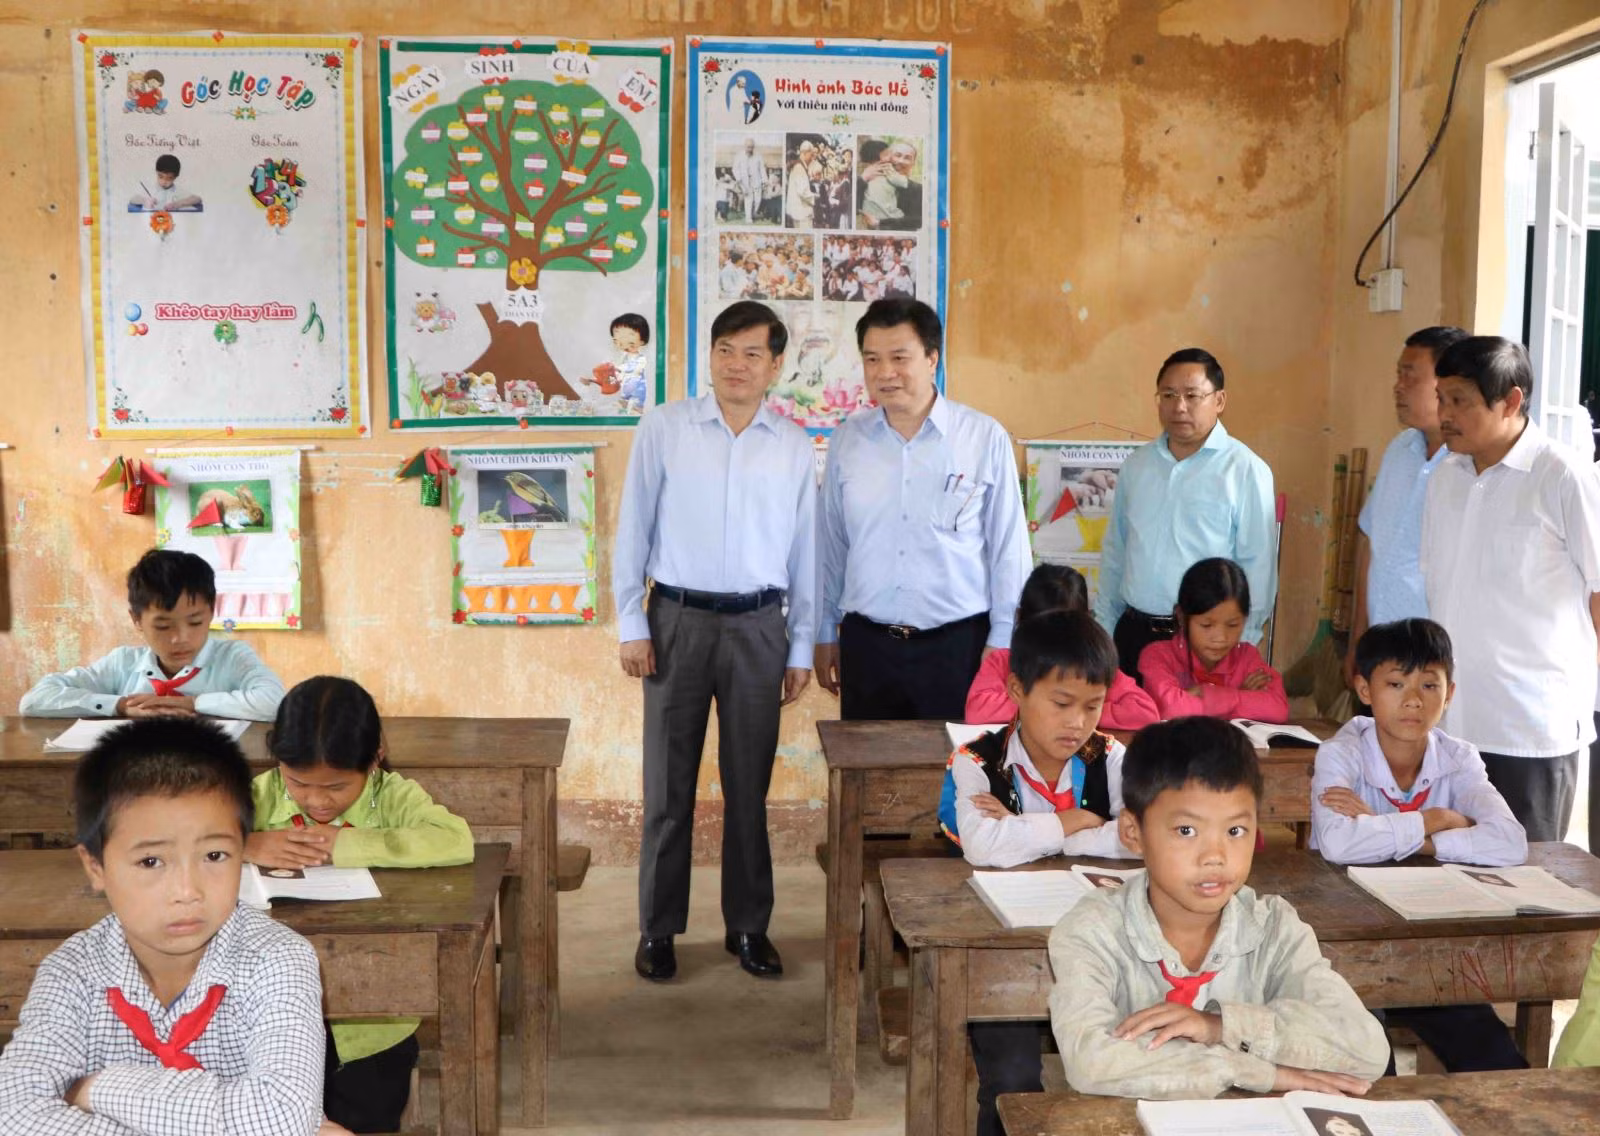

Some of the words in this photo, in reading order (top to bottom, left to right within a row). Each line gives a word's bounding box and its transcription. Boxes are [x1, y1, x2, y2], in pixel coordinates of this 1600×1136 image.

[471, 59, 514, 75] SINH
[626, 76, 652, 102] EM
[201, 304, 231, 321] tay
[230, 303, 261, 322] hay
[501, 455, 529, 464] CHIM
[1091, 450, 1113, 460] CON
[222, 463, 246, 472] CON
